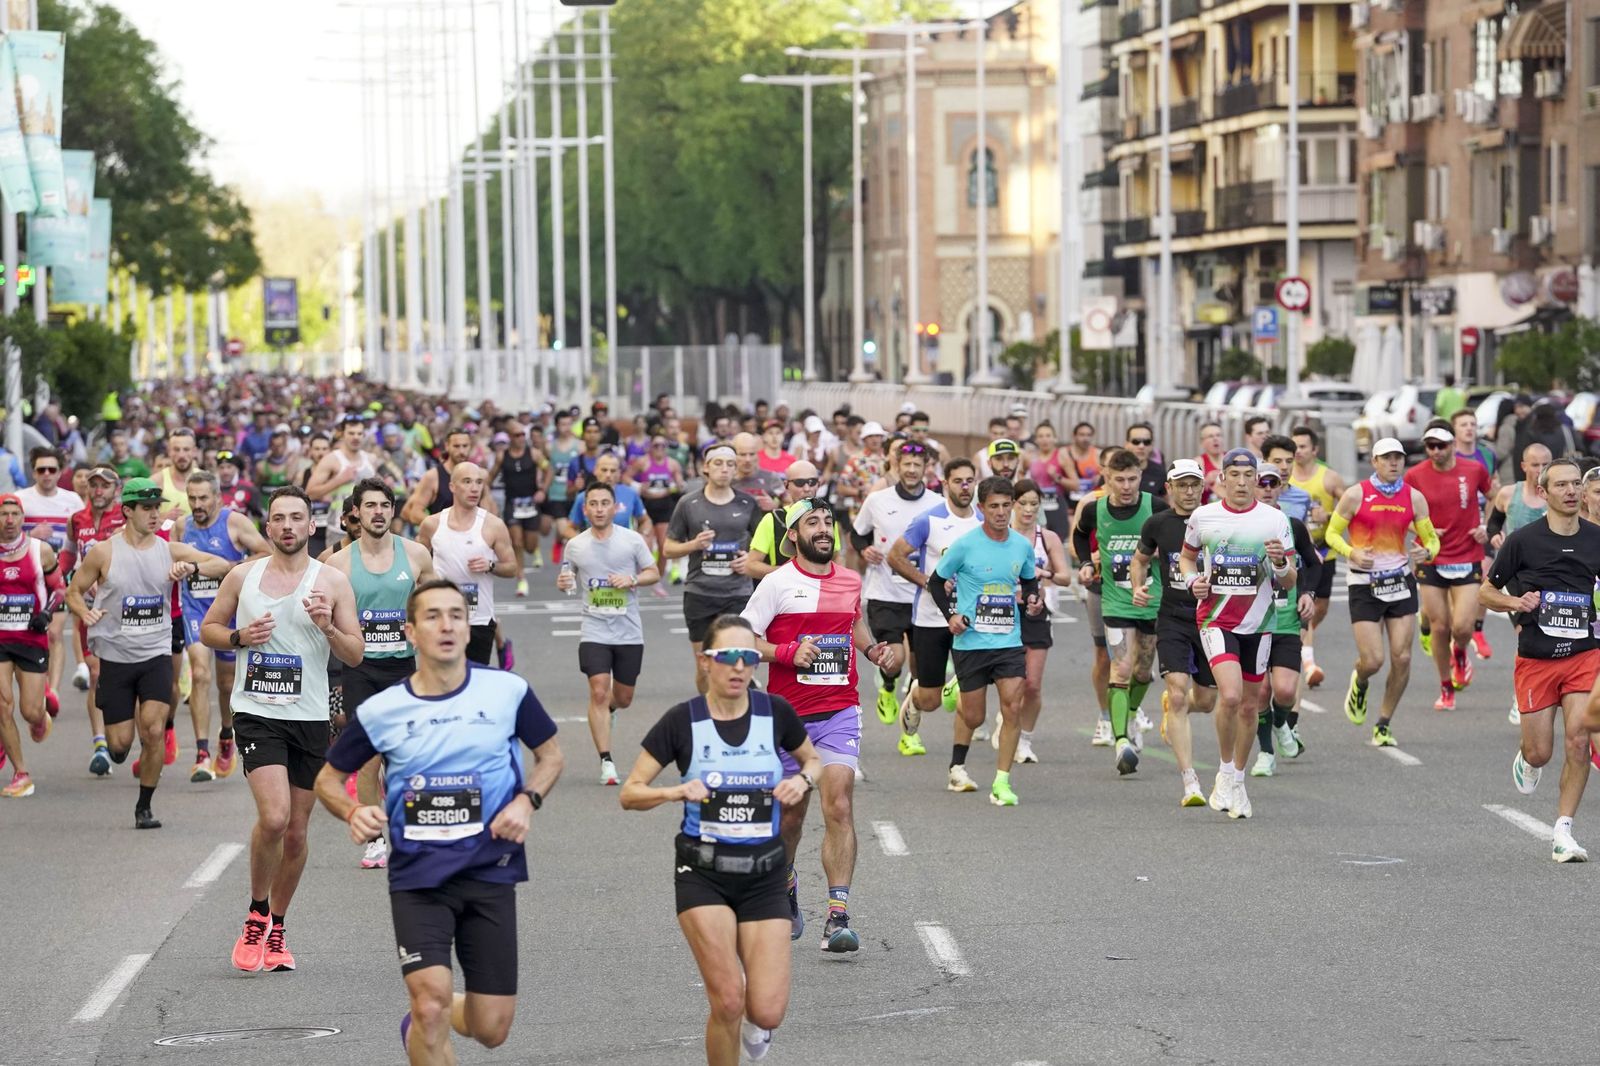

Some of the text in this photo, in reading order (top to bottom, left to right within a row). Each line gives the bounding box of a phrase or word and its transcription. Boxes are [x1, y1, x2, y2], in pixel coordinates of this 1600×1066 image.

[1217, 575, 1251, 586] CARLOS
[1558, 594, 1585, 604] ZURICH
[375, 611, 401, 619] ZURICH
[975, 615, 1014, 625] ALEXANDRE
[1548, 616, 1580, 628] JULIEN
[365, 631, 401, 642] BORNES
[264, 656, 296, 665] ZURICH
[813, 662, 838, 673] TOMI
[264, 671, 282, 680] 3593
[251, 680, 295, 693] FINNIAN
[430, 775, 473, 787] ZURICH
[726, 775, 768, 786] ZURICH
[726, 794, 750, 805] 4409
[417, 808, 470, 825] SERGIO
[718, 807, 756, 822] SUSY
